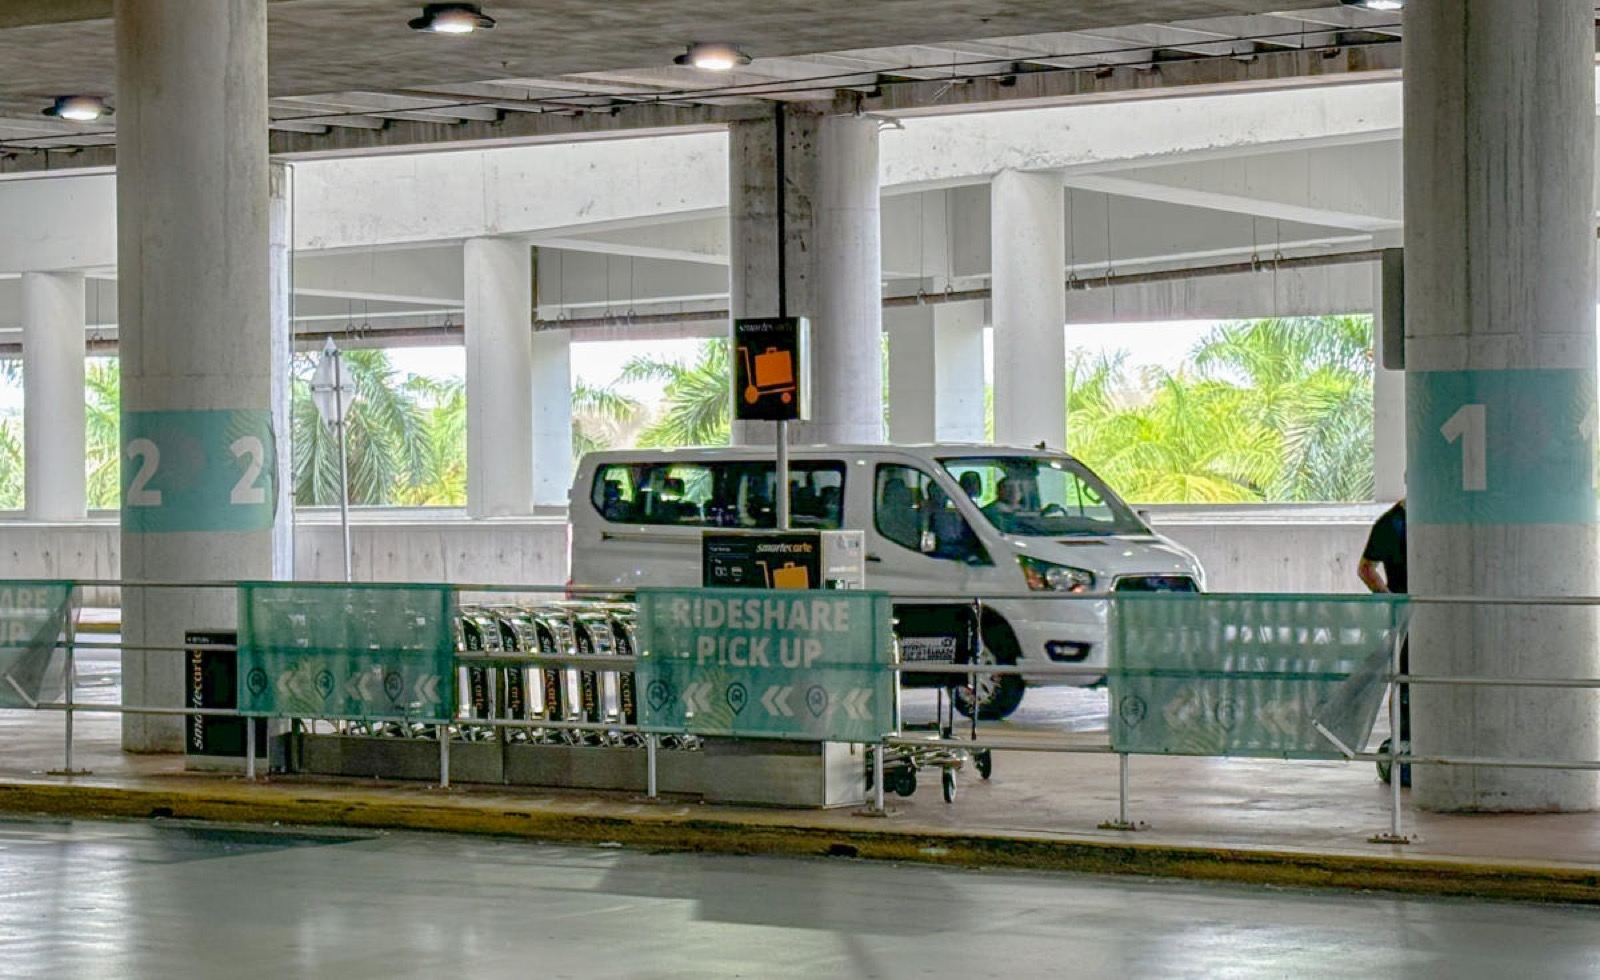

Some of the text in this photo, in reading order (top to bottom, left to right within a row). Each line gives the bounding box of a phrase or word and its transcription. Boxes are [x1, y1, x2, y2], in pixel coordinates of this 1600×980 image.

[126, 438, 162, 506] 2
[230, 436, 265, 504] 2
[1440, 404, 1487, 491] 1
[672, 598, 850, 632] RIDESHARE
[696, 635, 825, 669] PICK UP
[192, 649, 203, 750] smatecarte
